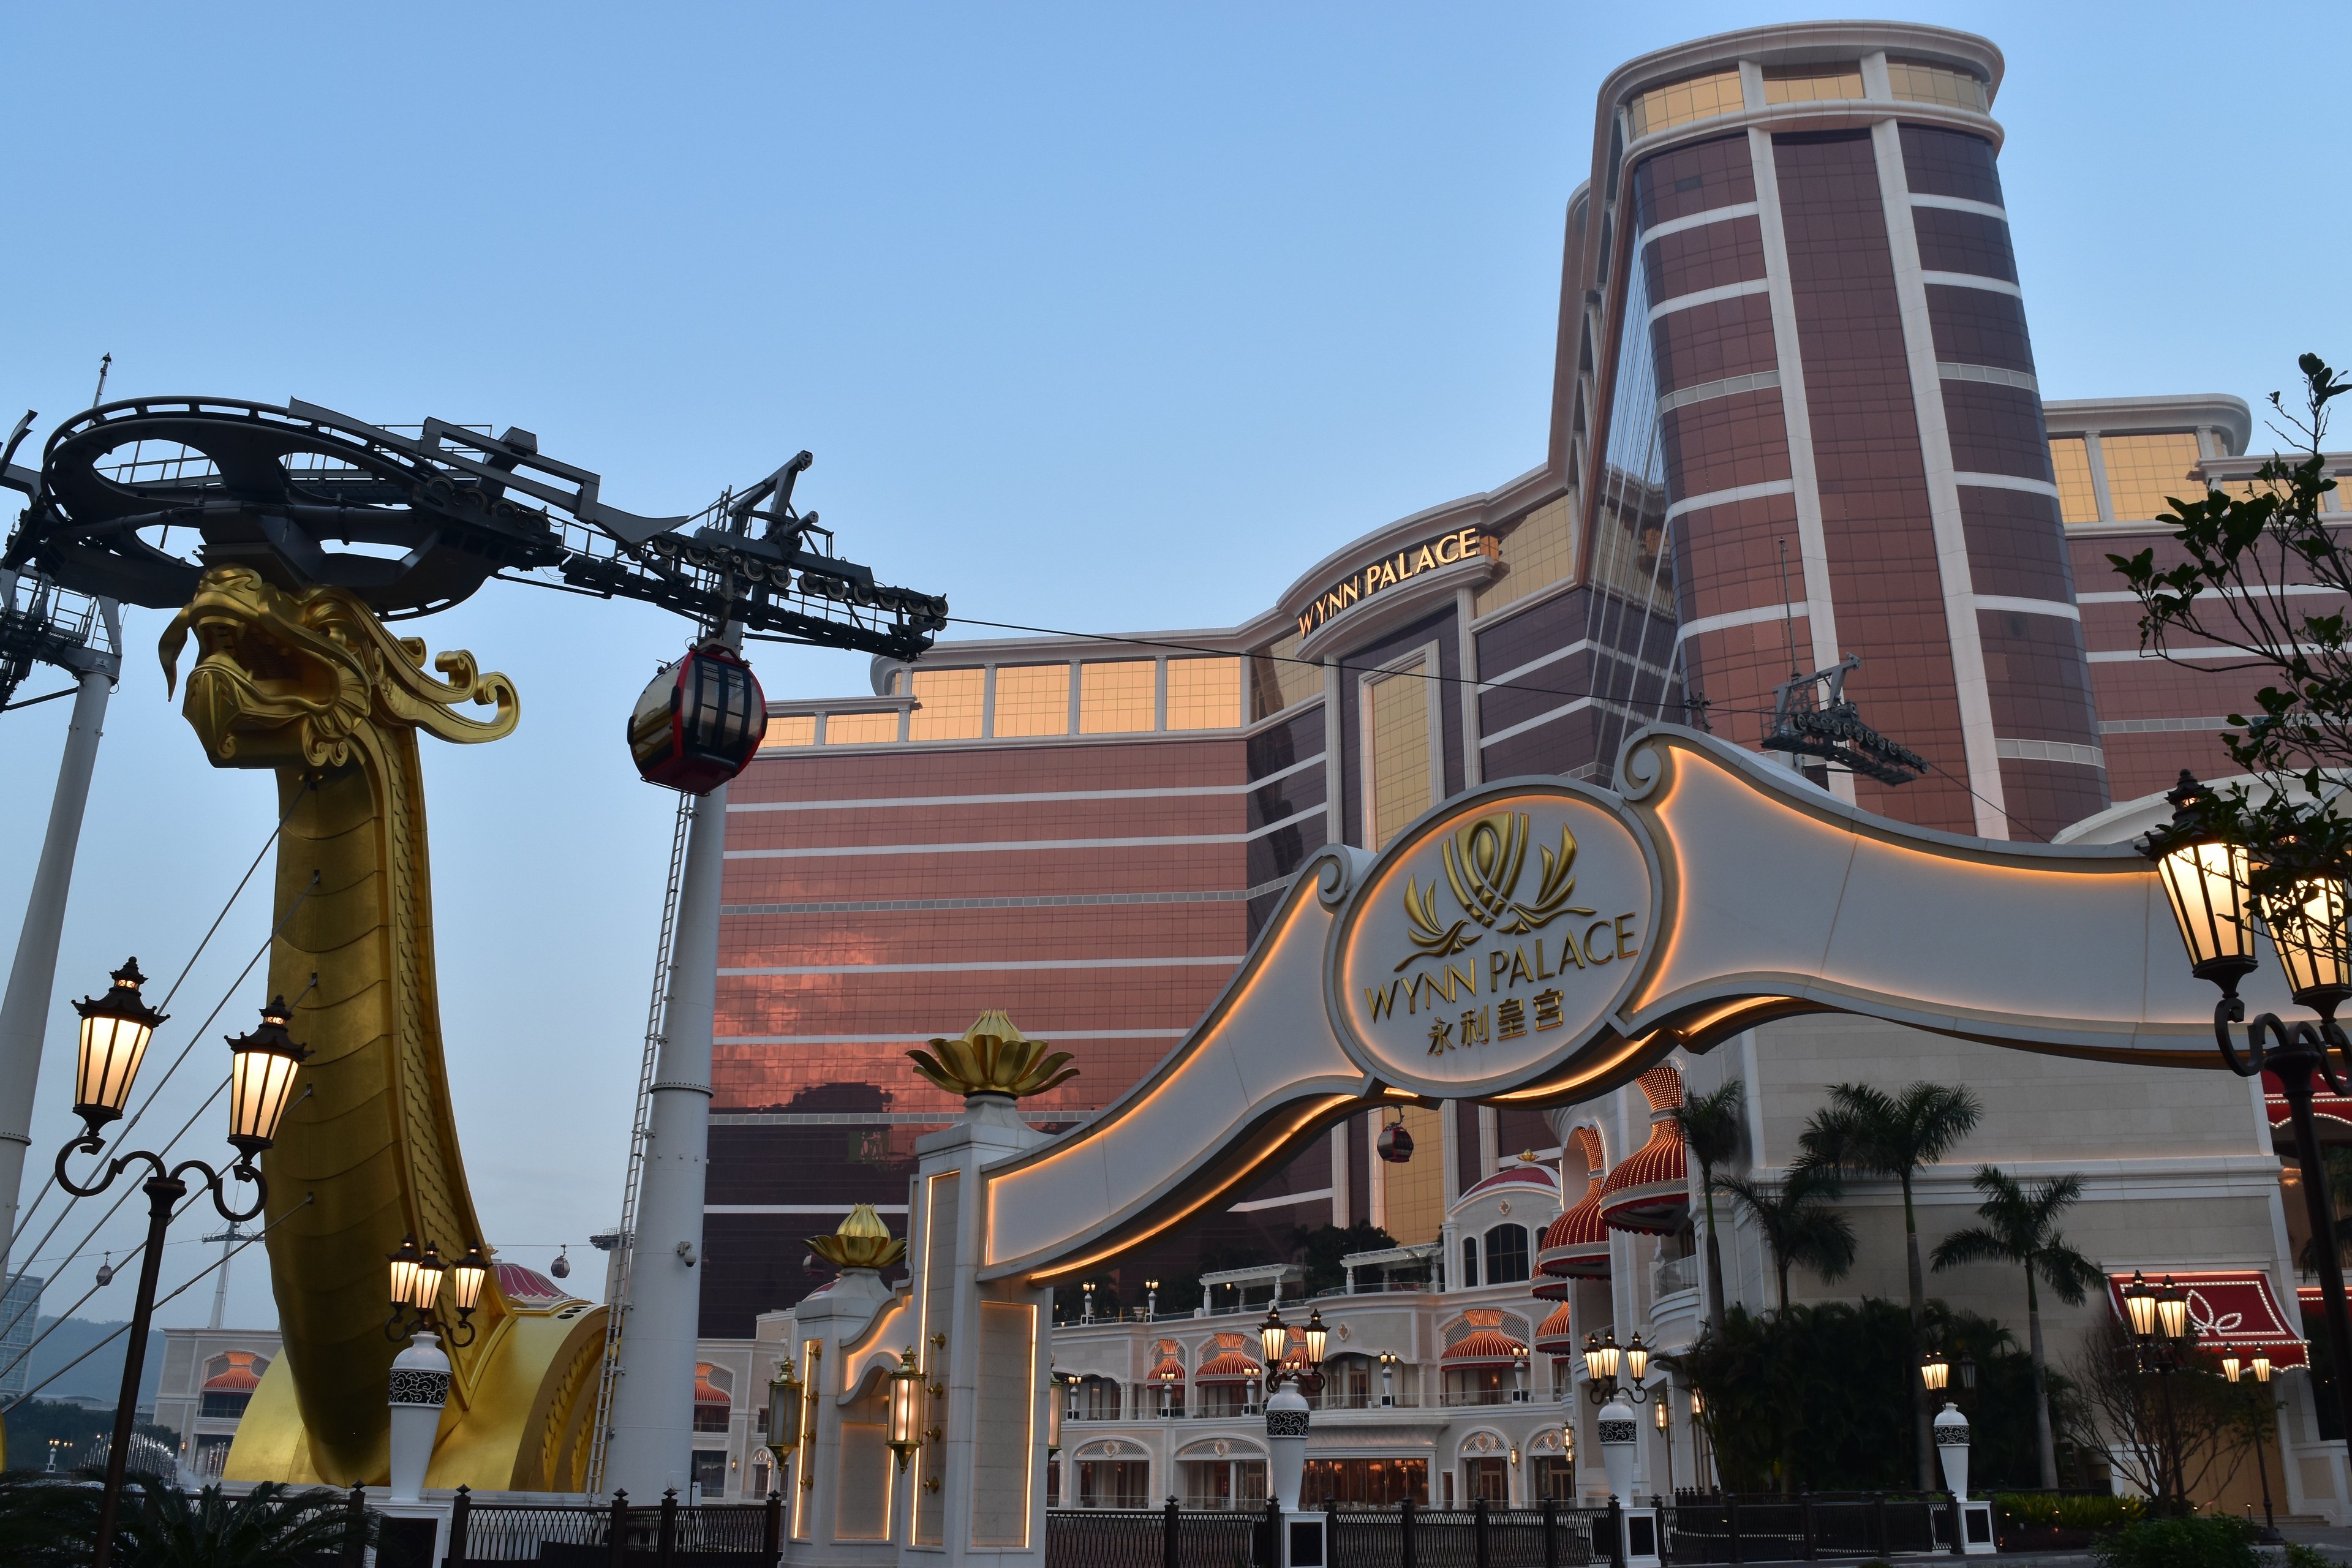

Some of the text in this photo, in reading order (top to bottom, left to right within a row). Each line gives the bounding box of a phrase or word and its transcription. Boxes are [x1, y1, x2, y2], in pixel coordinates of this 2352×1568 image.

[1298, 527, 1477, 638] WYNN PALACE
[1365, 912, 1638, 1023] WYNN PALACE
[1428, 988, 1564, 1055] 永利皇宮
